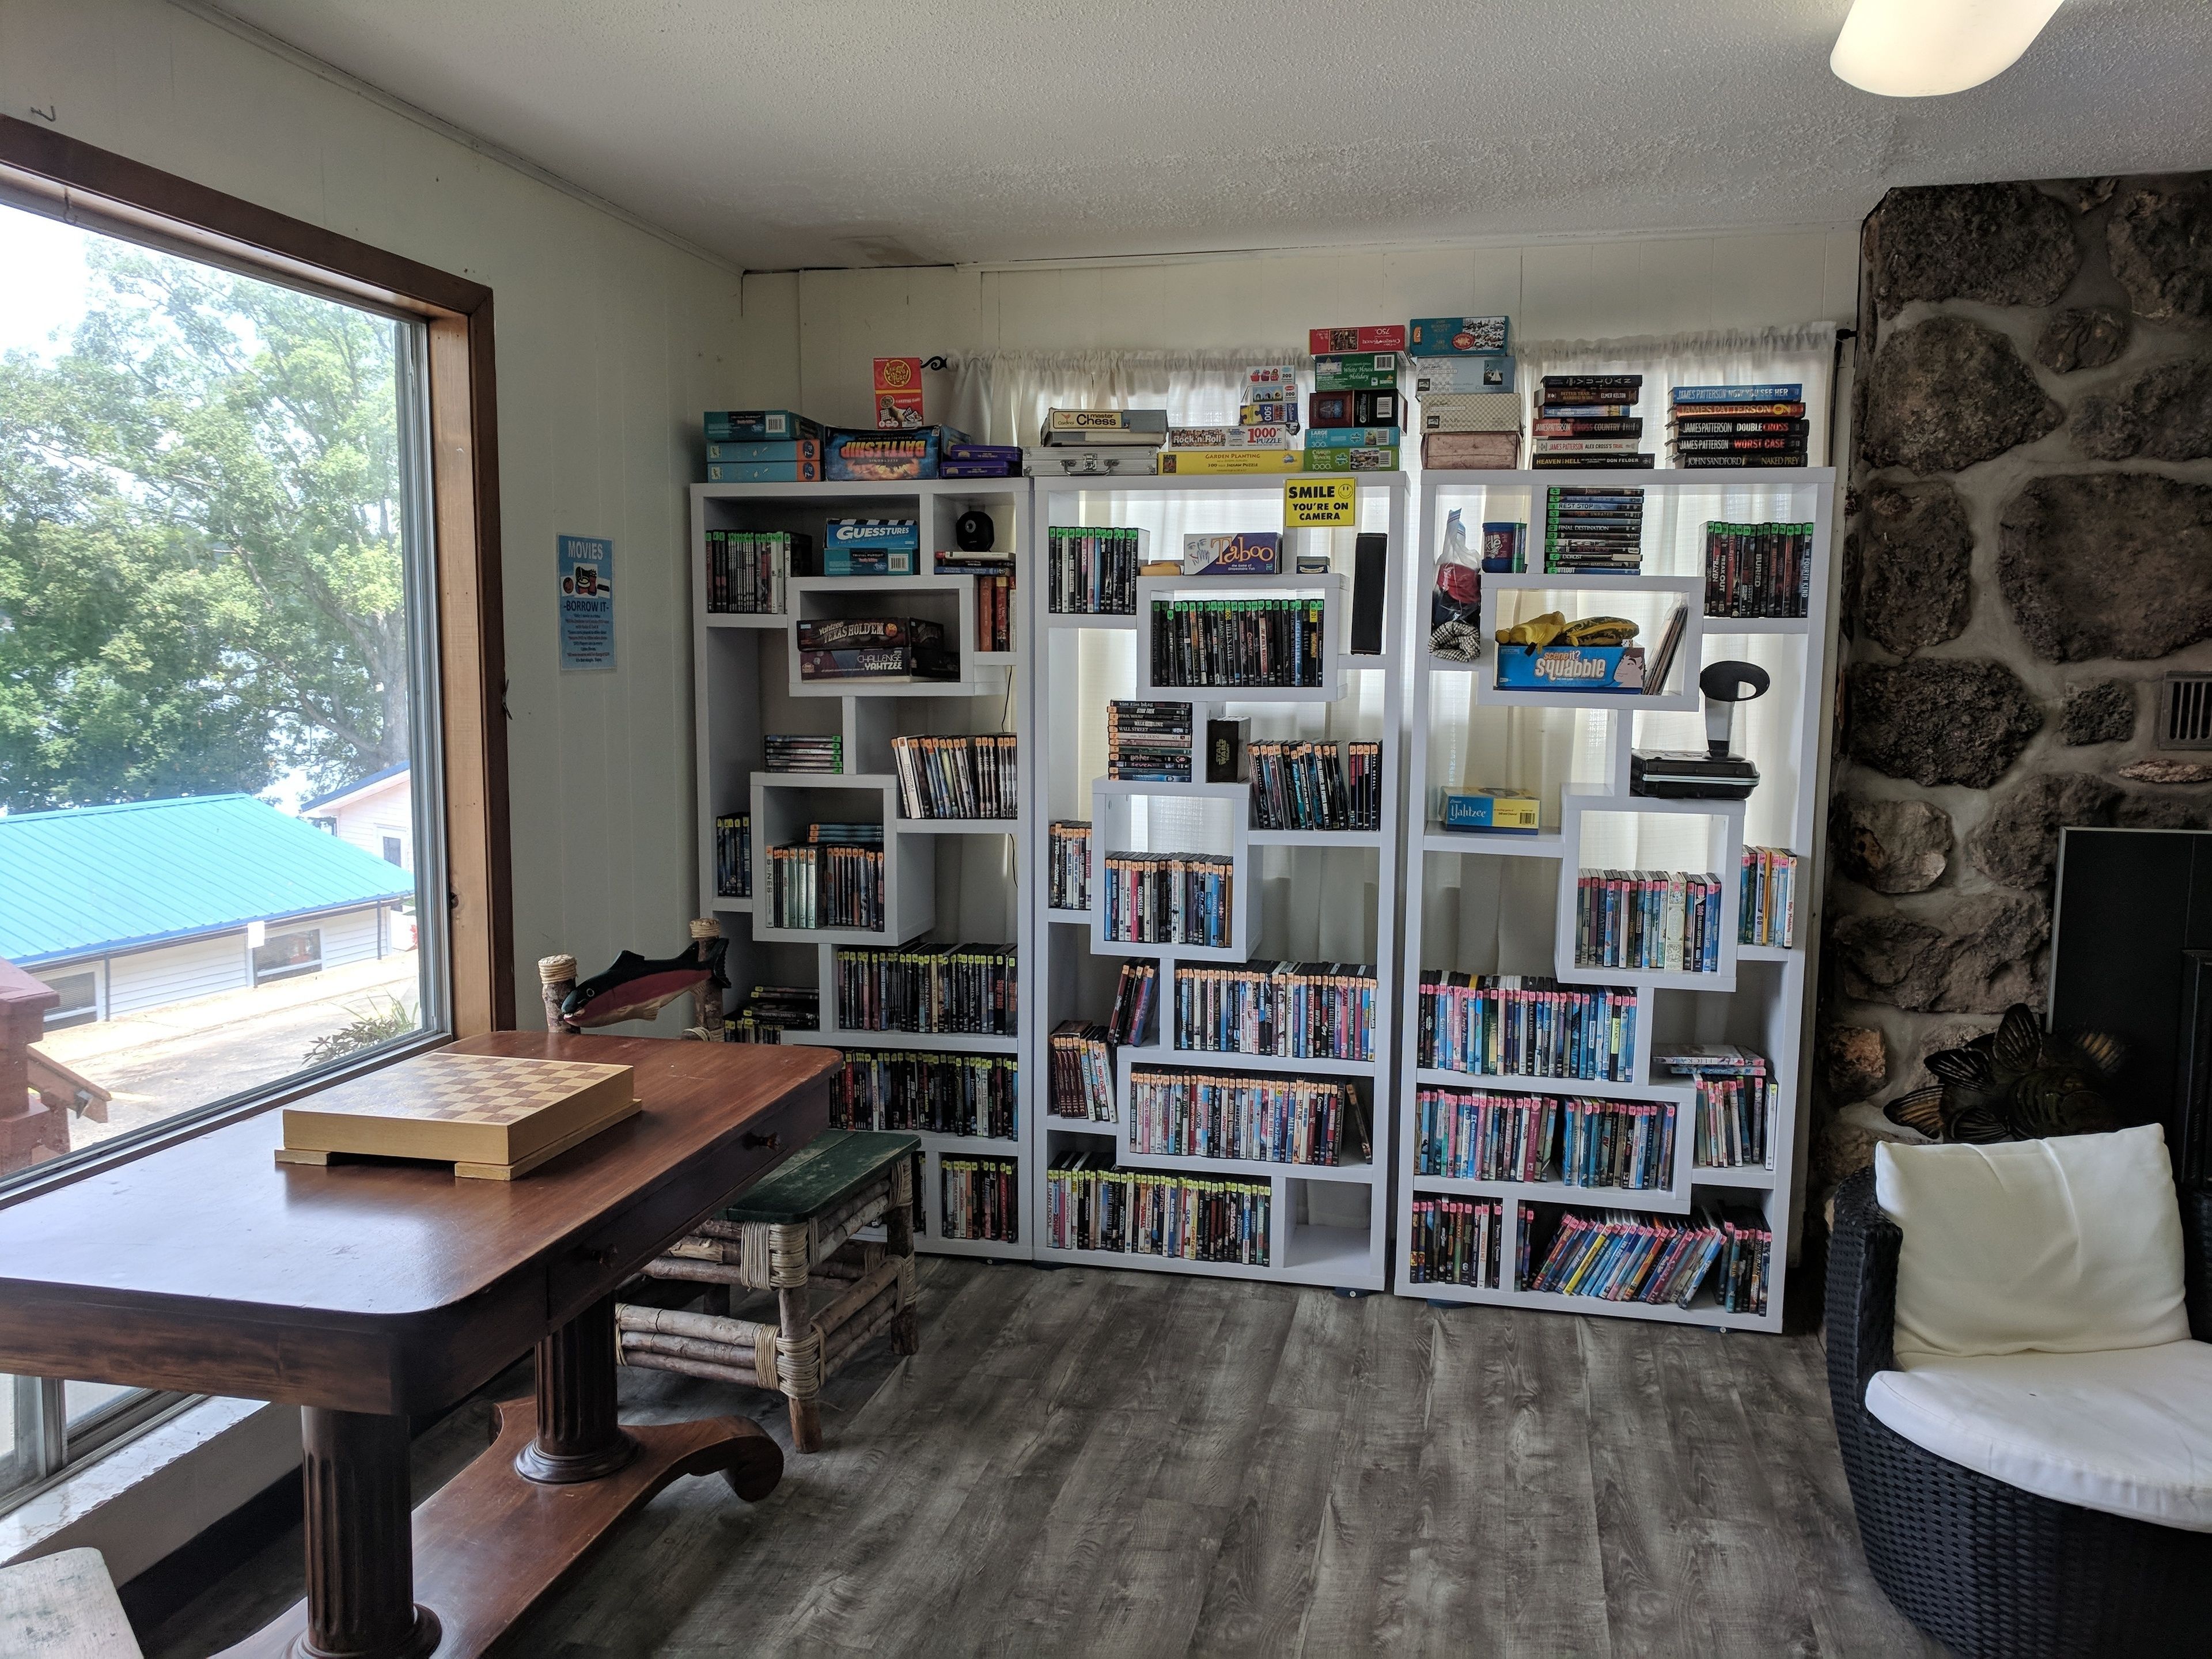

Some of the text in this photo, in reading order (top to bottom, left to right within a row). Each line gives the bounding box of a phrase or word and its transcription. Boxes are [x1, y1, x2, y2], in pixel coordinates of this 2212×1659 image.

[1676, 389, 1696, 400] JAMES
[1696, 388, 1726, 400] PATTERSON
[1760, 388, 1773, 396] SEE
[1774, 388, 1788, 396] HER
[1264, 406, 1272, 422] 500
[1682, 404, 1771, 414] JAMES PATTERSON
[1076, 414, 1116, 425] Chess
[1535, 423, 1548, 432] JAMES
[1548, 423, 1570, 431] PATTERSON
[1593, 423, 1620, 431] COUNTRY
[1683, 422, 1789, 433] JAMES PATTERSON DOUBLE CROSS
[1247, 427, 1277, 444] 1000
[840, 440, 926, 459] BATTLESHIP
[1562, 442, 1583, 450] PATTERSON
[1680, 439, 1786, 449] JAMES PATTERSON WORST CASE
[1688, 456, 1800, 467] JOHN SANDFORD NAKED PREY
[1288, 486, 1335, 499] SMILE
[1293, 502, 1349, 510] YOU'RE ON
[1298, 513, 1341, 521] CAMERA
[836, 525, 909, 540] GUESSTURES
[568, 540, 604, 560] MOVIES
[1211, 536, 1274, 565] Taboo
[1755, 553, 1763, 588] BURIED
[1802, 558, 1811, 581] FOURTH
[1801, 582, 1809, 598] KIND
[818, 621, 843, 636] Yahtzee
[823, 626, 848, 644] TEXAS
[857, 654, 902, 662] CHALLENGE
[1544, 650, 1581, 661] scene it?
[864, 661, 902, 671] YAHTZEE
[1535, 658, 1606, 682] squabble
[1449, 803, 1486, 821] Yahtzee
